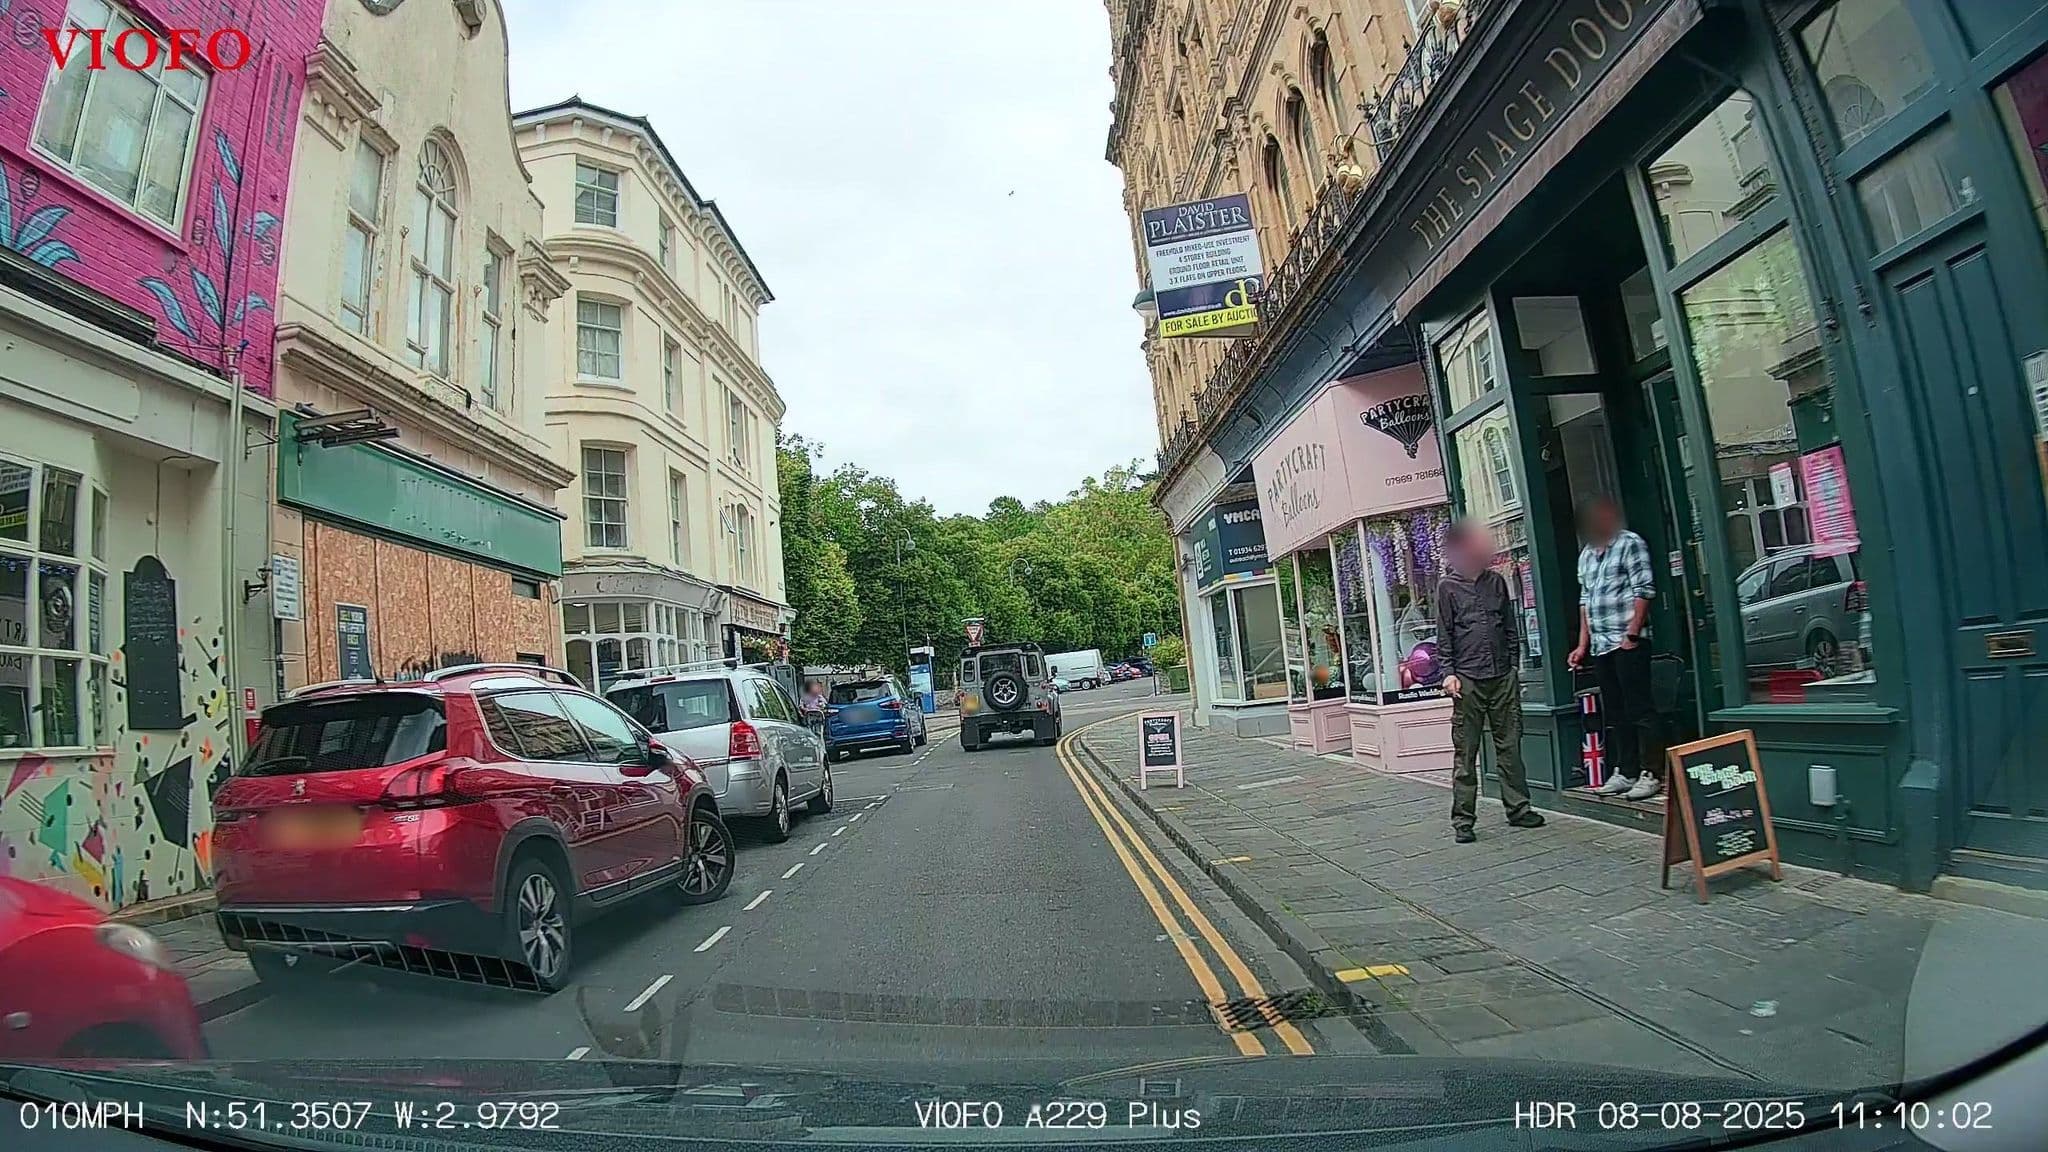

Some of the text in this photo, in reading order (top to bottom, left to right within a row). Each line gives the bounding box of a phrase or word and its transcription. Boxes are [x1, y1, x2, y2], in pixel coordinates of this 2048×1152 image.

[1410, 0, 1652, 251] THE STAGE DOO
[1178, 202, 1215, 217] DAVID
[1148, 206, 1249, 238] PLAISTER
[1216, 235, 1250, 248] INVESTMENT
[1183, 253, 1205, 263] STOREY
[1193, 262, 1211, 272] FLOOR
[1207, 269, 1225, 279] UPPER
[1226, 265, 1248, 276] FLOORS
[1165, 320, 1184, 334] FOR
[1186, 316, 1211, 329] SALE
[1212, 312, 1226, 325] BY
[1361, 395, 1431, 424] PARTYCRA
[1379, 410, 1430, 430] Balloons
[1267, 442, 1327, 512] PARTYCRAFT
[1281, 482, 1320, 529] Balloons
[1223, 509, 1261, 525] YMCA
[1233, 546, 1253, 556] 01934
